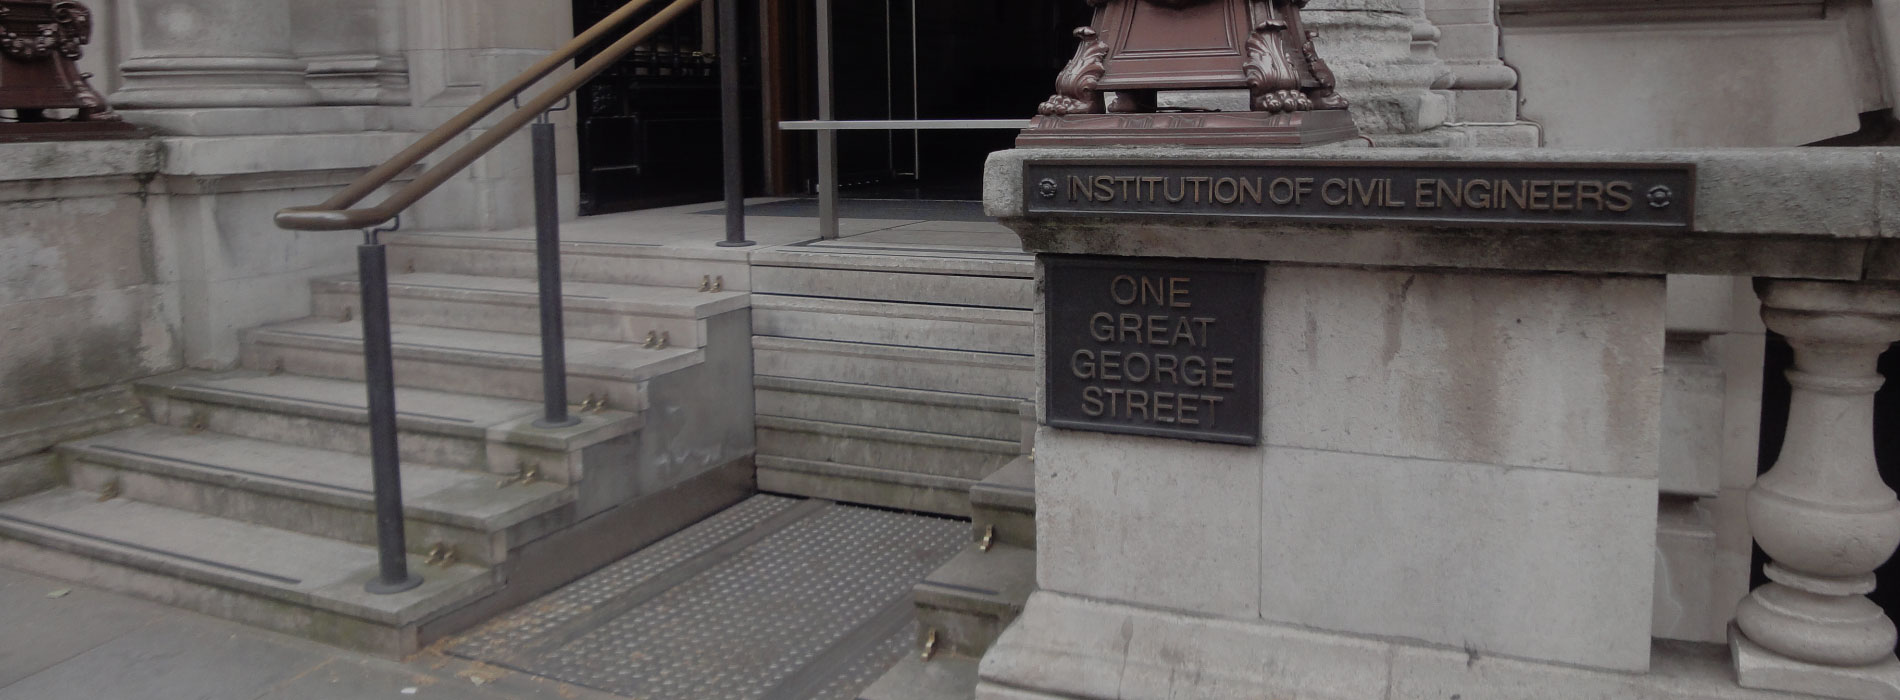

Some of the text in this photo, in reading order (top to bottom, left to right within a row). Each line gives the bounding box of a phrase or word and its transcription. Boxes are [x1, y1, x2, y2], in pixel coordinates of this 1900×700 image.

[1067, 175, 1633, 211] INSTITUTION OF CIVIL ENGINEERS
[1111, 274, 1191, 307] ONE
[1090, 312, 1216, 347] GREAT
[1071, 349, 1234, 389] GEORGE
[1081, 386, 1224, 427] STREET
